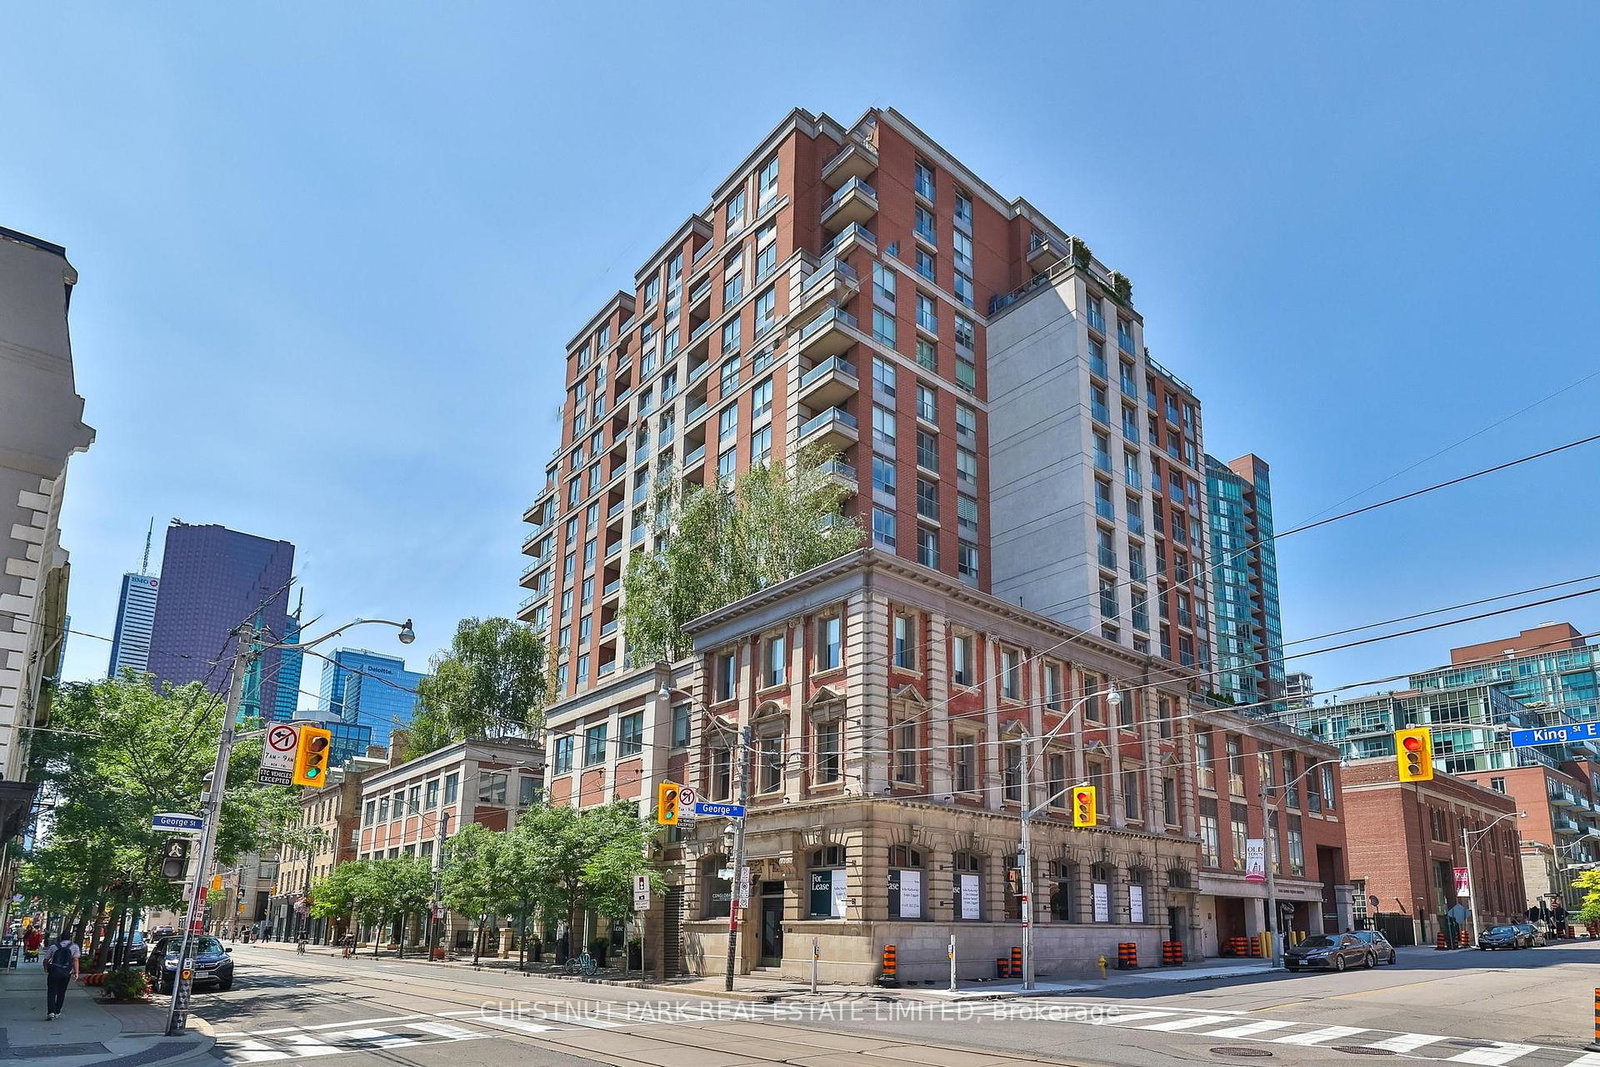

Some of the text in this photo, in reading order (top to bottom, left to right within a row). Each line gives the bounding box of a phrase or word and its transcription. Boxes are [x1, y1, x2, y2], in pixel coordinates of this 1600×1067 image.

[1533, 728, 1568, 742] King
[1587, 723, 1597, 736] E
[260, 775, 290, 785] EXCEPTED
[271, 771, 292, 779] VEHICLES
[702, 804, 731, 815] George
[160, 817, 189, 827] George
[811, 873, 823, 883] For
[811, 881, 830, 891] Lease
